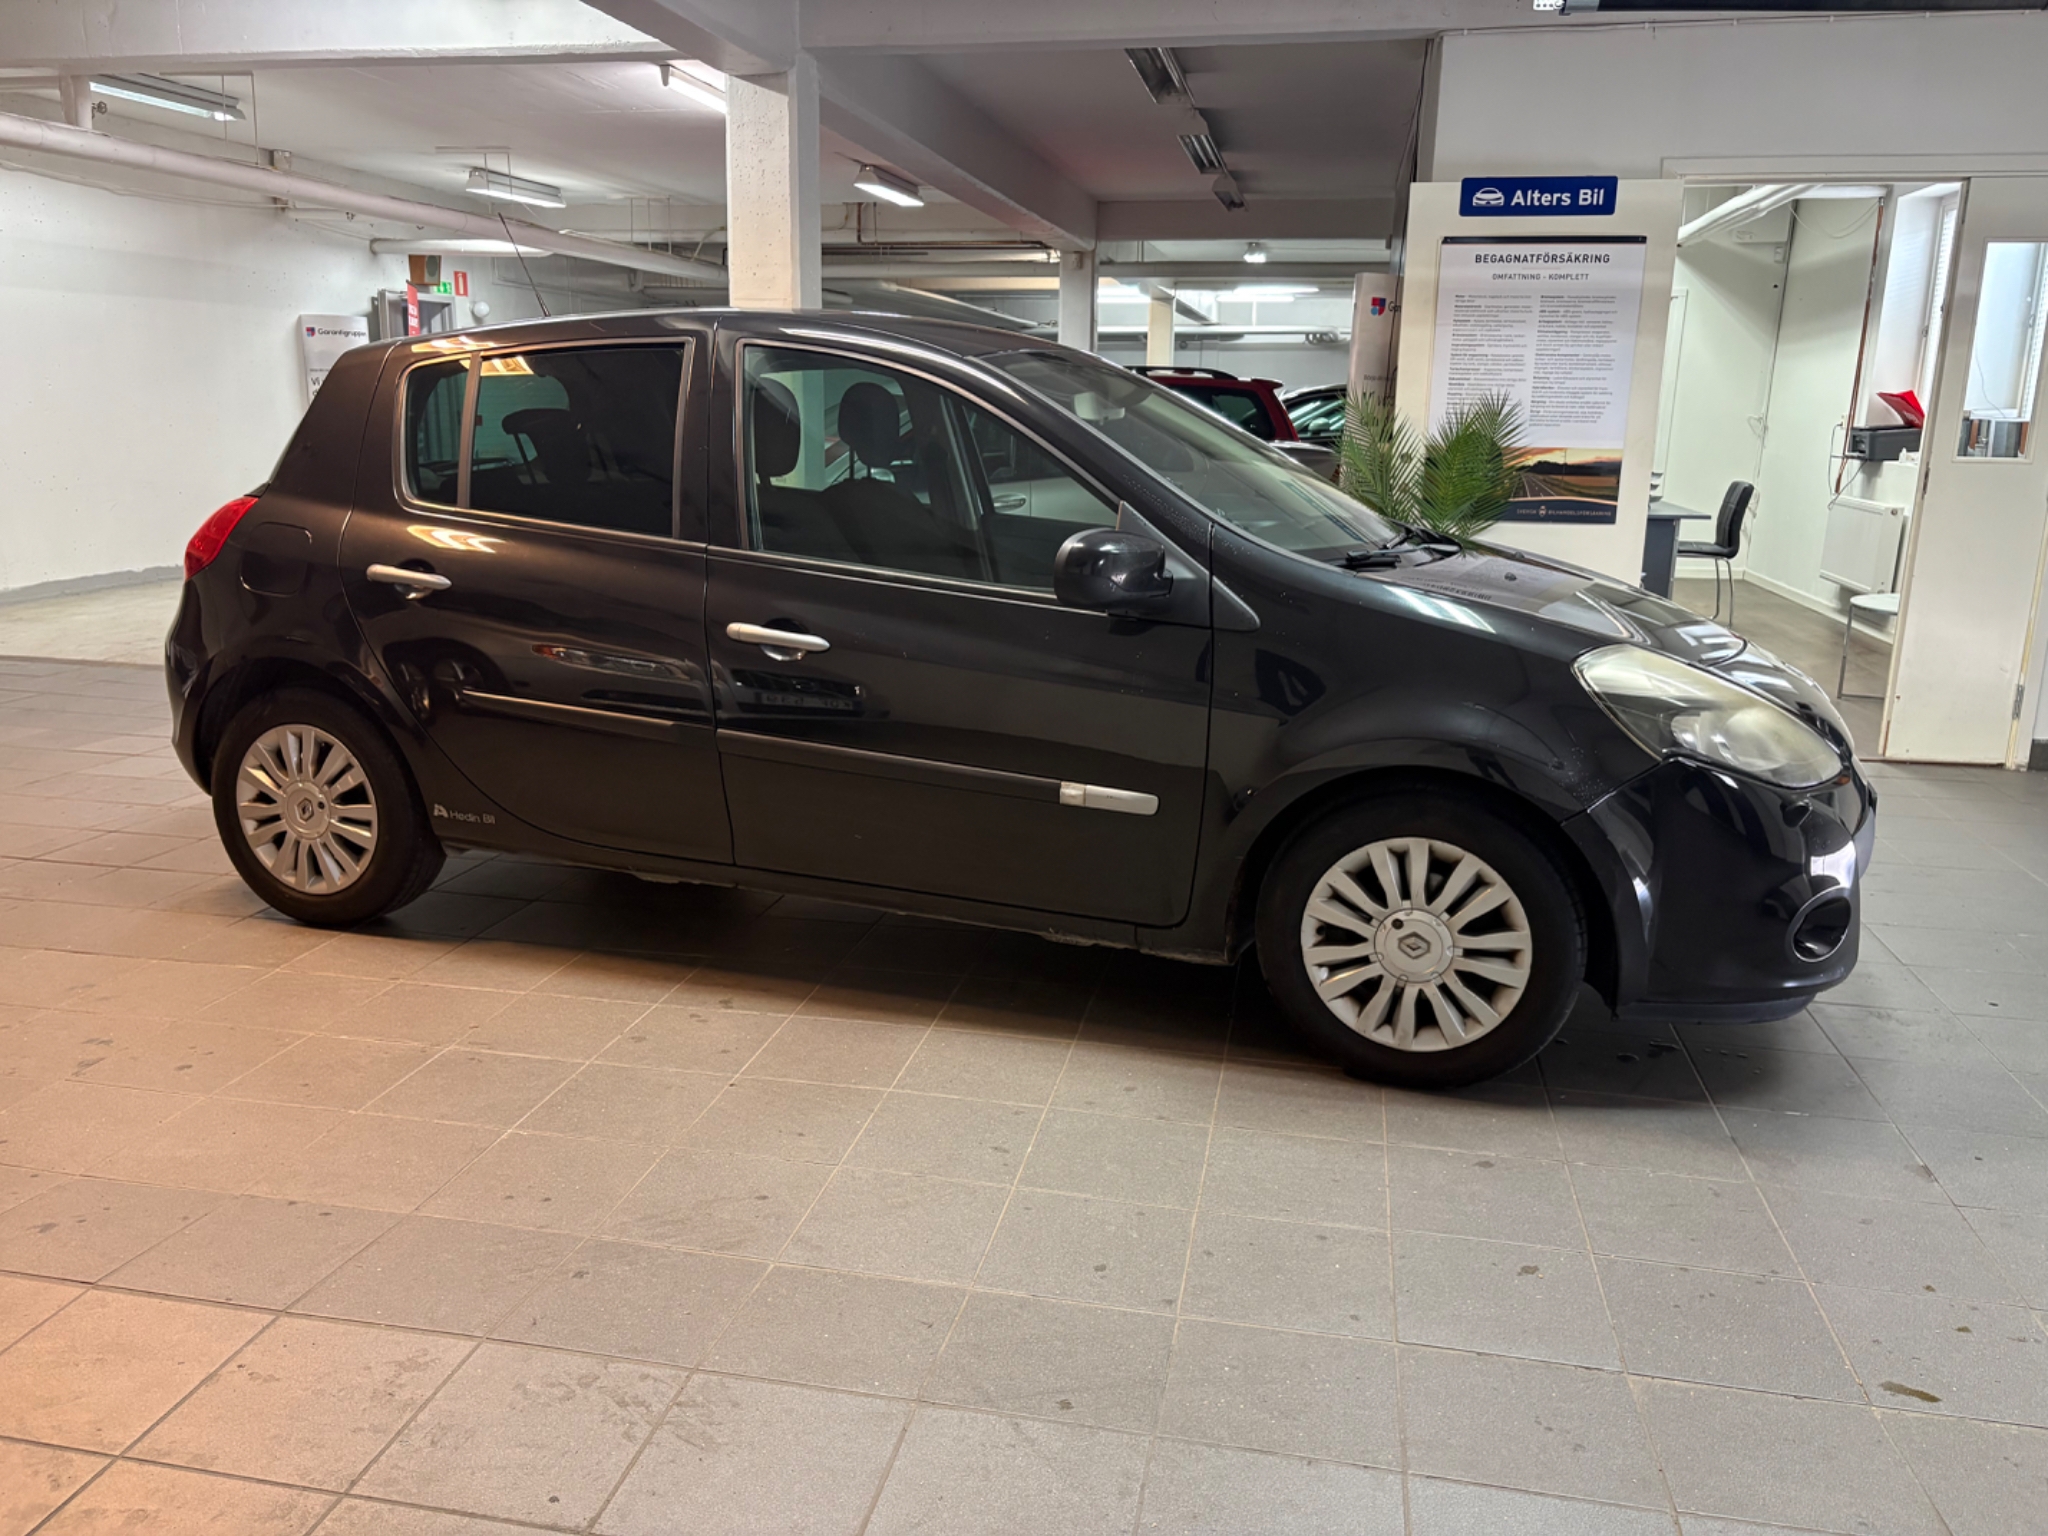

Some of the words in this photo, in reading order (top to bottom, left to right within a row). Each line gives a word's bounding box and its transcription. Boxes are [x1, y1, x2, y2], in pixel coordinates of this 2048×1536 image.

[1510, 189, 1571, 206] Alters
[1578, 188, 1604, 206] Bil
[1475, 252, 1610, 264] BEGAGNATFÖRSÄKRING
[1492, 273, 1541, 281] OMFATTNING
[1548, 273, 1589, 281] KOMPLETT
